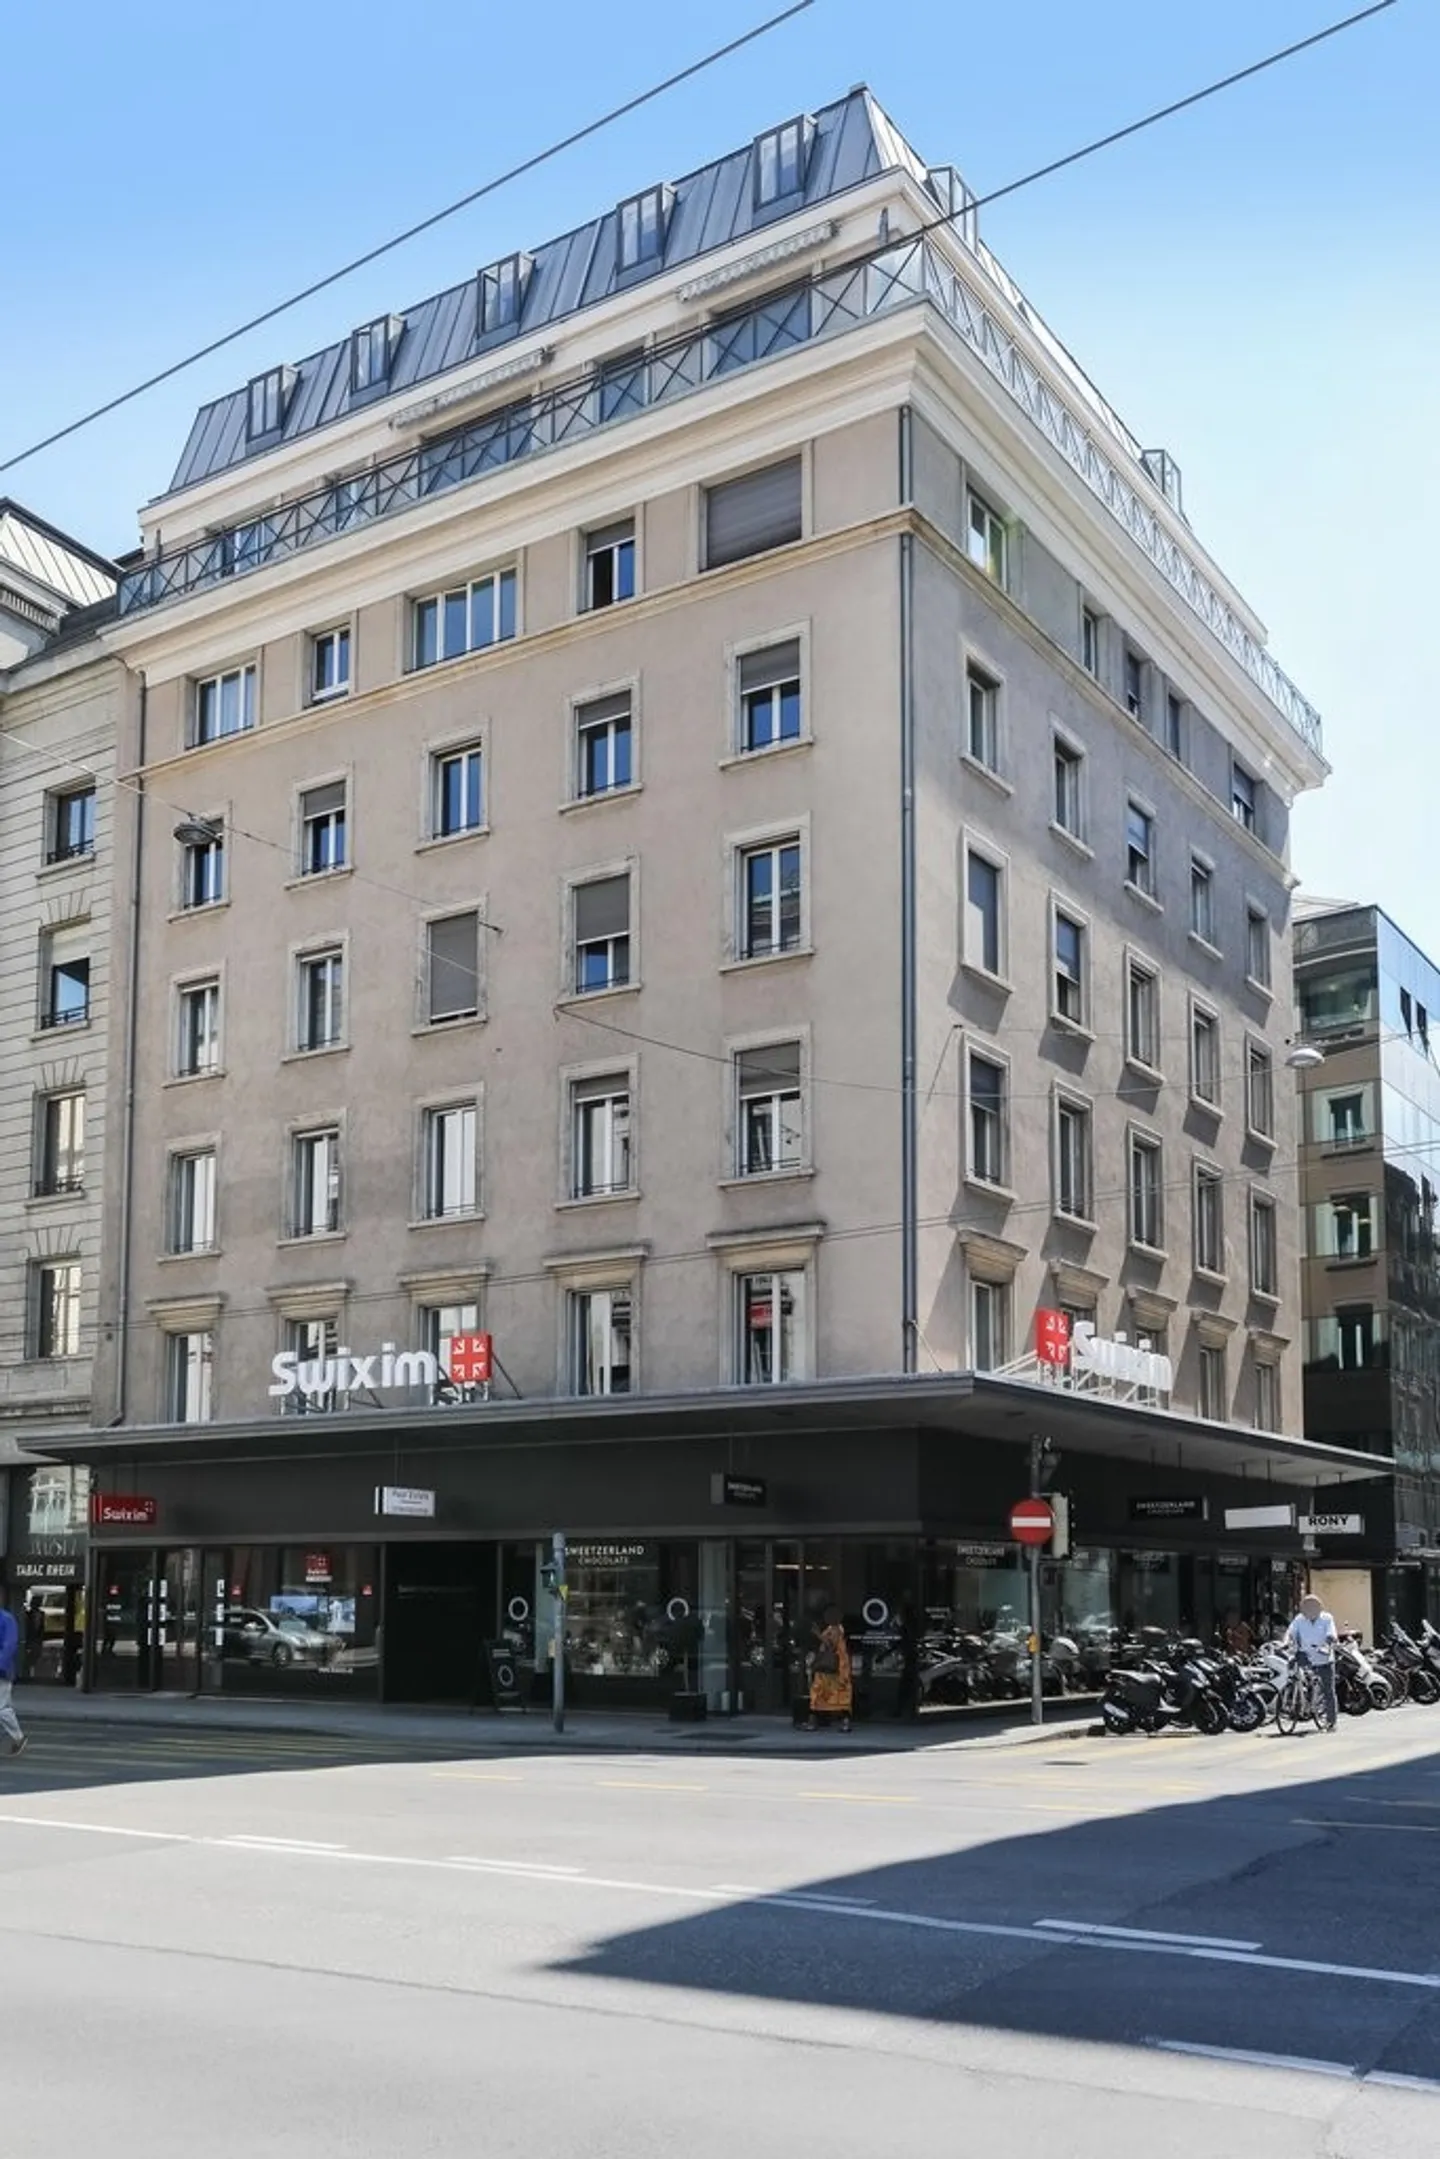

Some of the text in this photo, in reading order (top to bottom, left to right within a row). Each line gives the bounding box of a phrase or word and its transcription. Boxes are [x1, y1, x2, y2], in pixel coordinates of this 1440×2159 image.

[268, 1342, 438, 1396] Swixim
[103, 1507, 148, 1520] Swixim
[1309, 1515, 1349, 1526] RONY
[16, 1564, 44, 1577] TABAC
